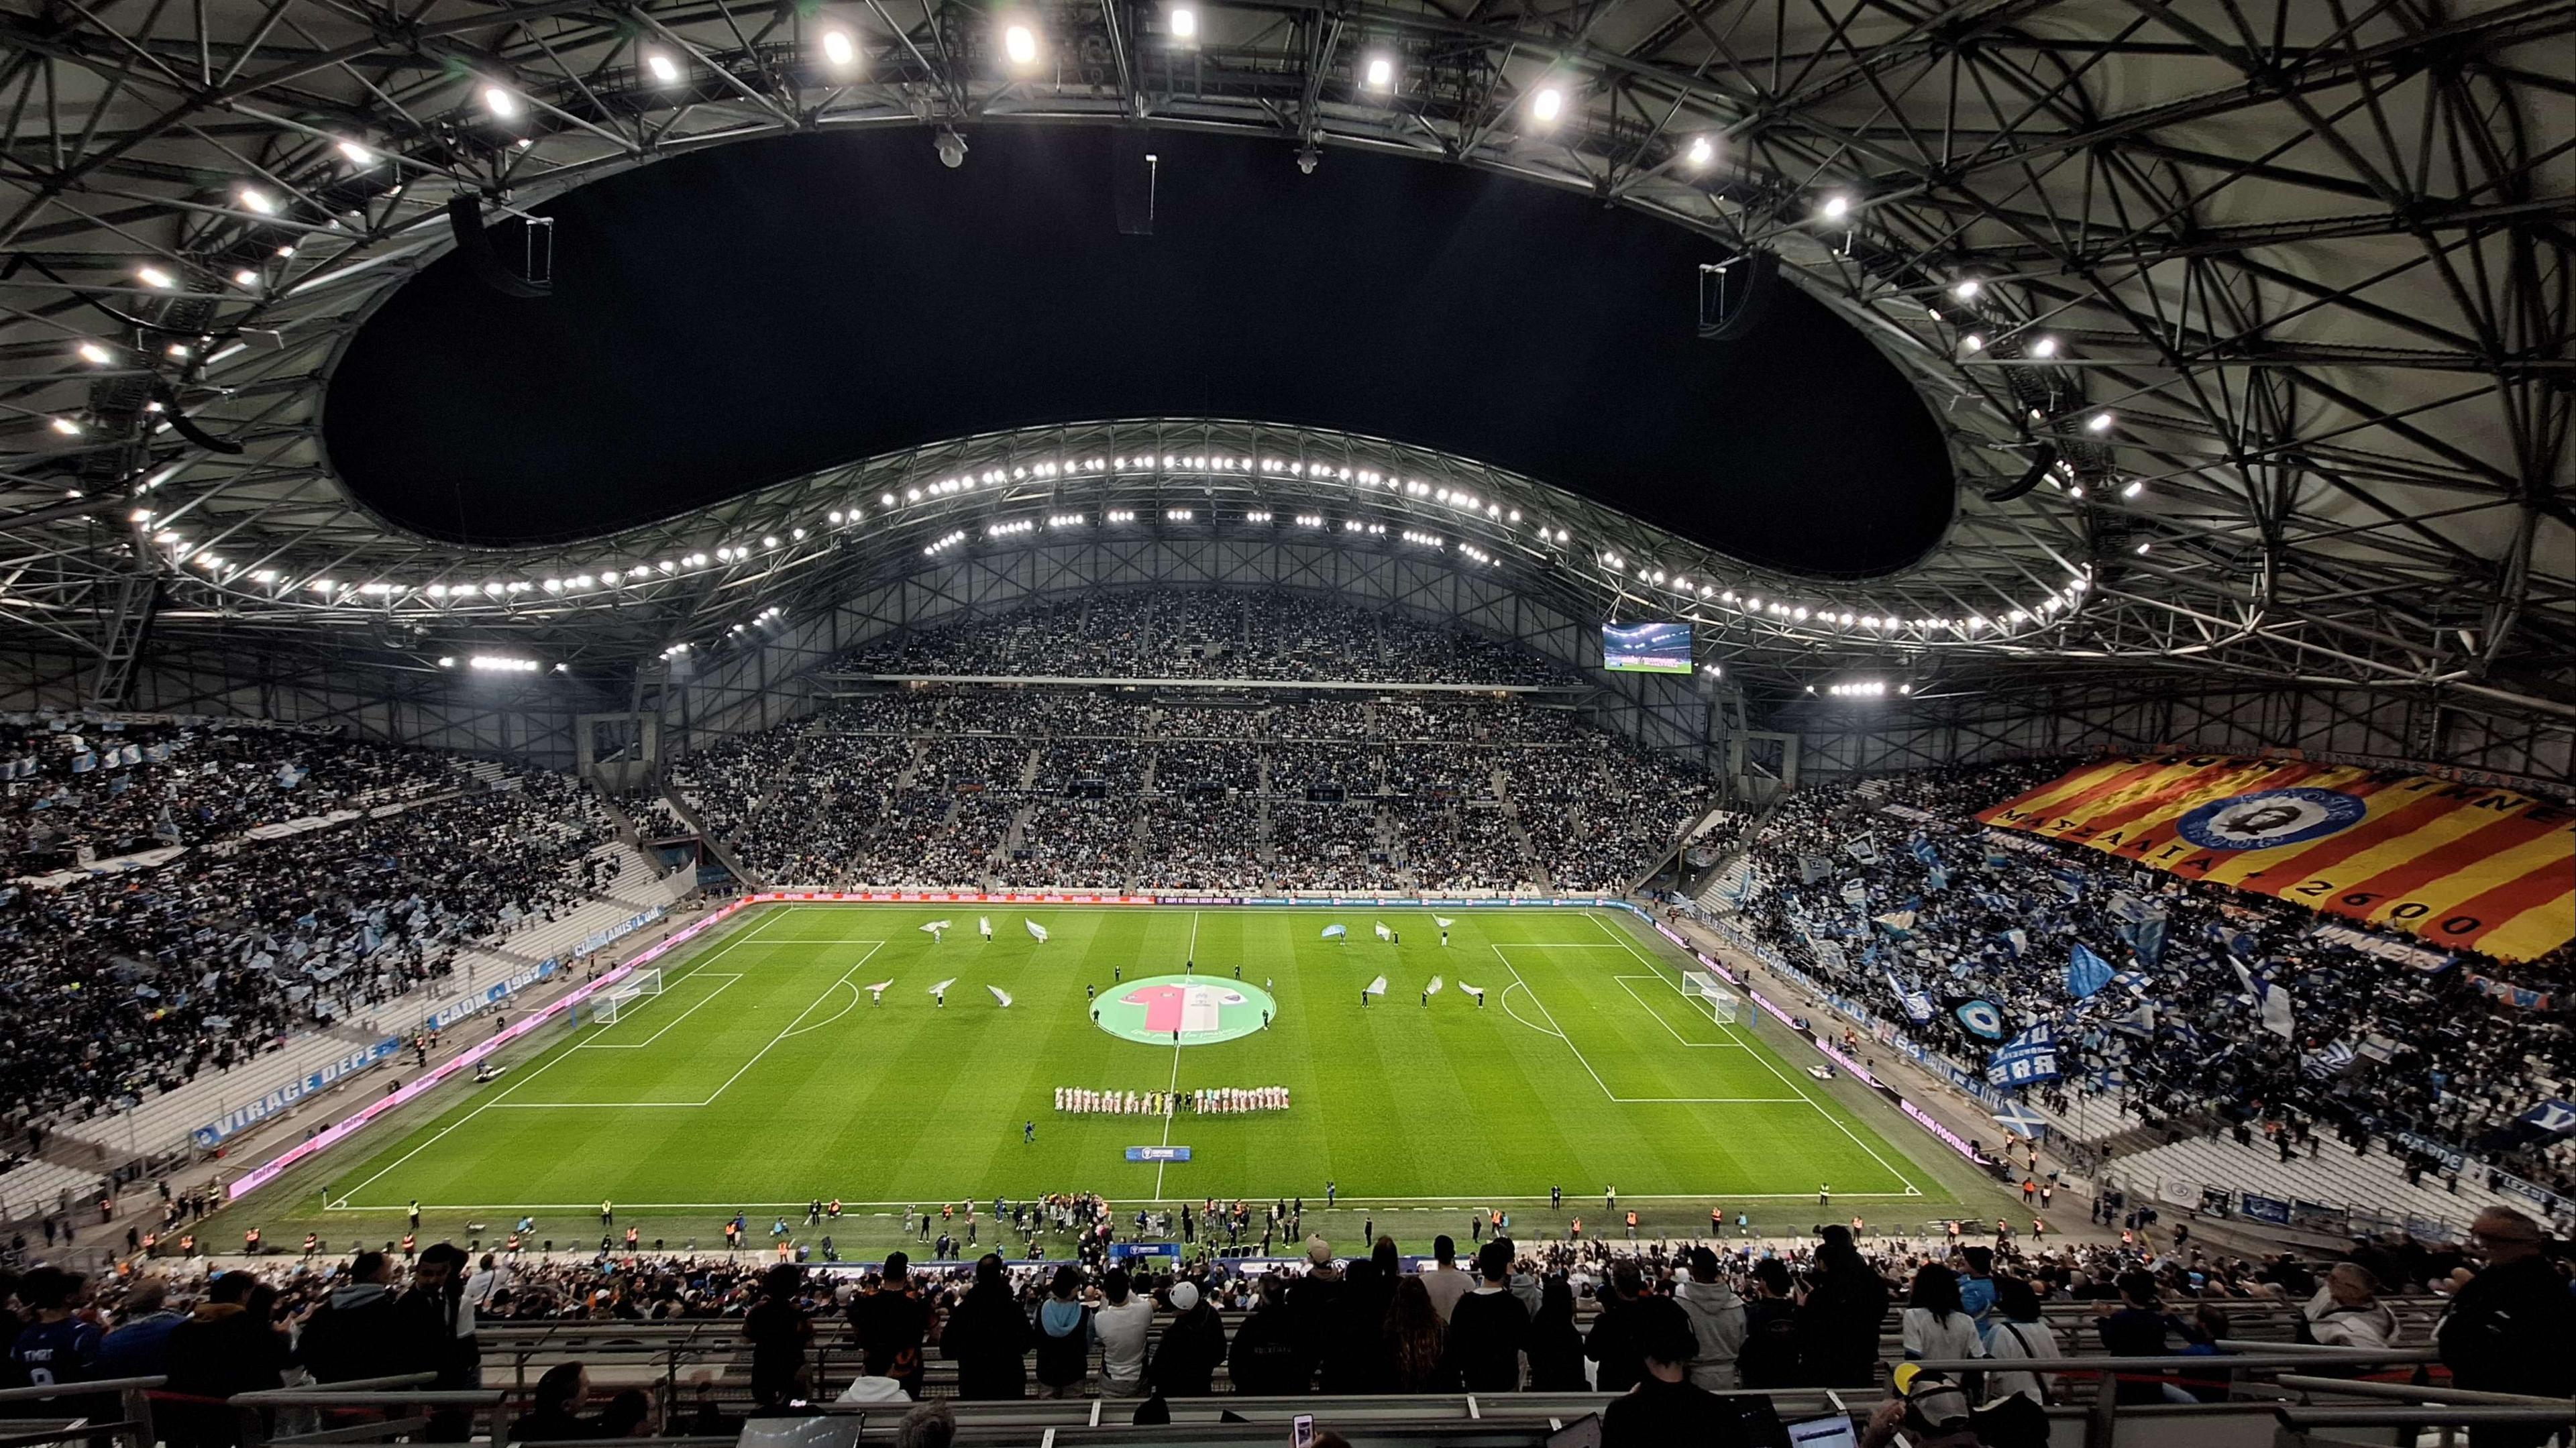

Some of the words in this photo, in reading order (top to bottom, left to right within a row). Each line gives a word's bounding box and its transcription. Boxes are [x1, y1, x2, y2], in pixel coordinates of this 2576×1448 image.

[608, 920, 633, 941] AMIS
[2296, 880, 2482, 935] 2600
[2312, 924, 2449, 969] WINNERS
[437, 992, 490, 1026] CAOM
[505, 964, 541, 993] 1987
[1895, 1034, 1920, 1059] 84
[214, 1075, 314, 1137] VIRAGE
[321, 1044, 378, 1083] DEPE
[1901, 1099, 1973, 1159] NIKE.COM/FOOTBALL
